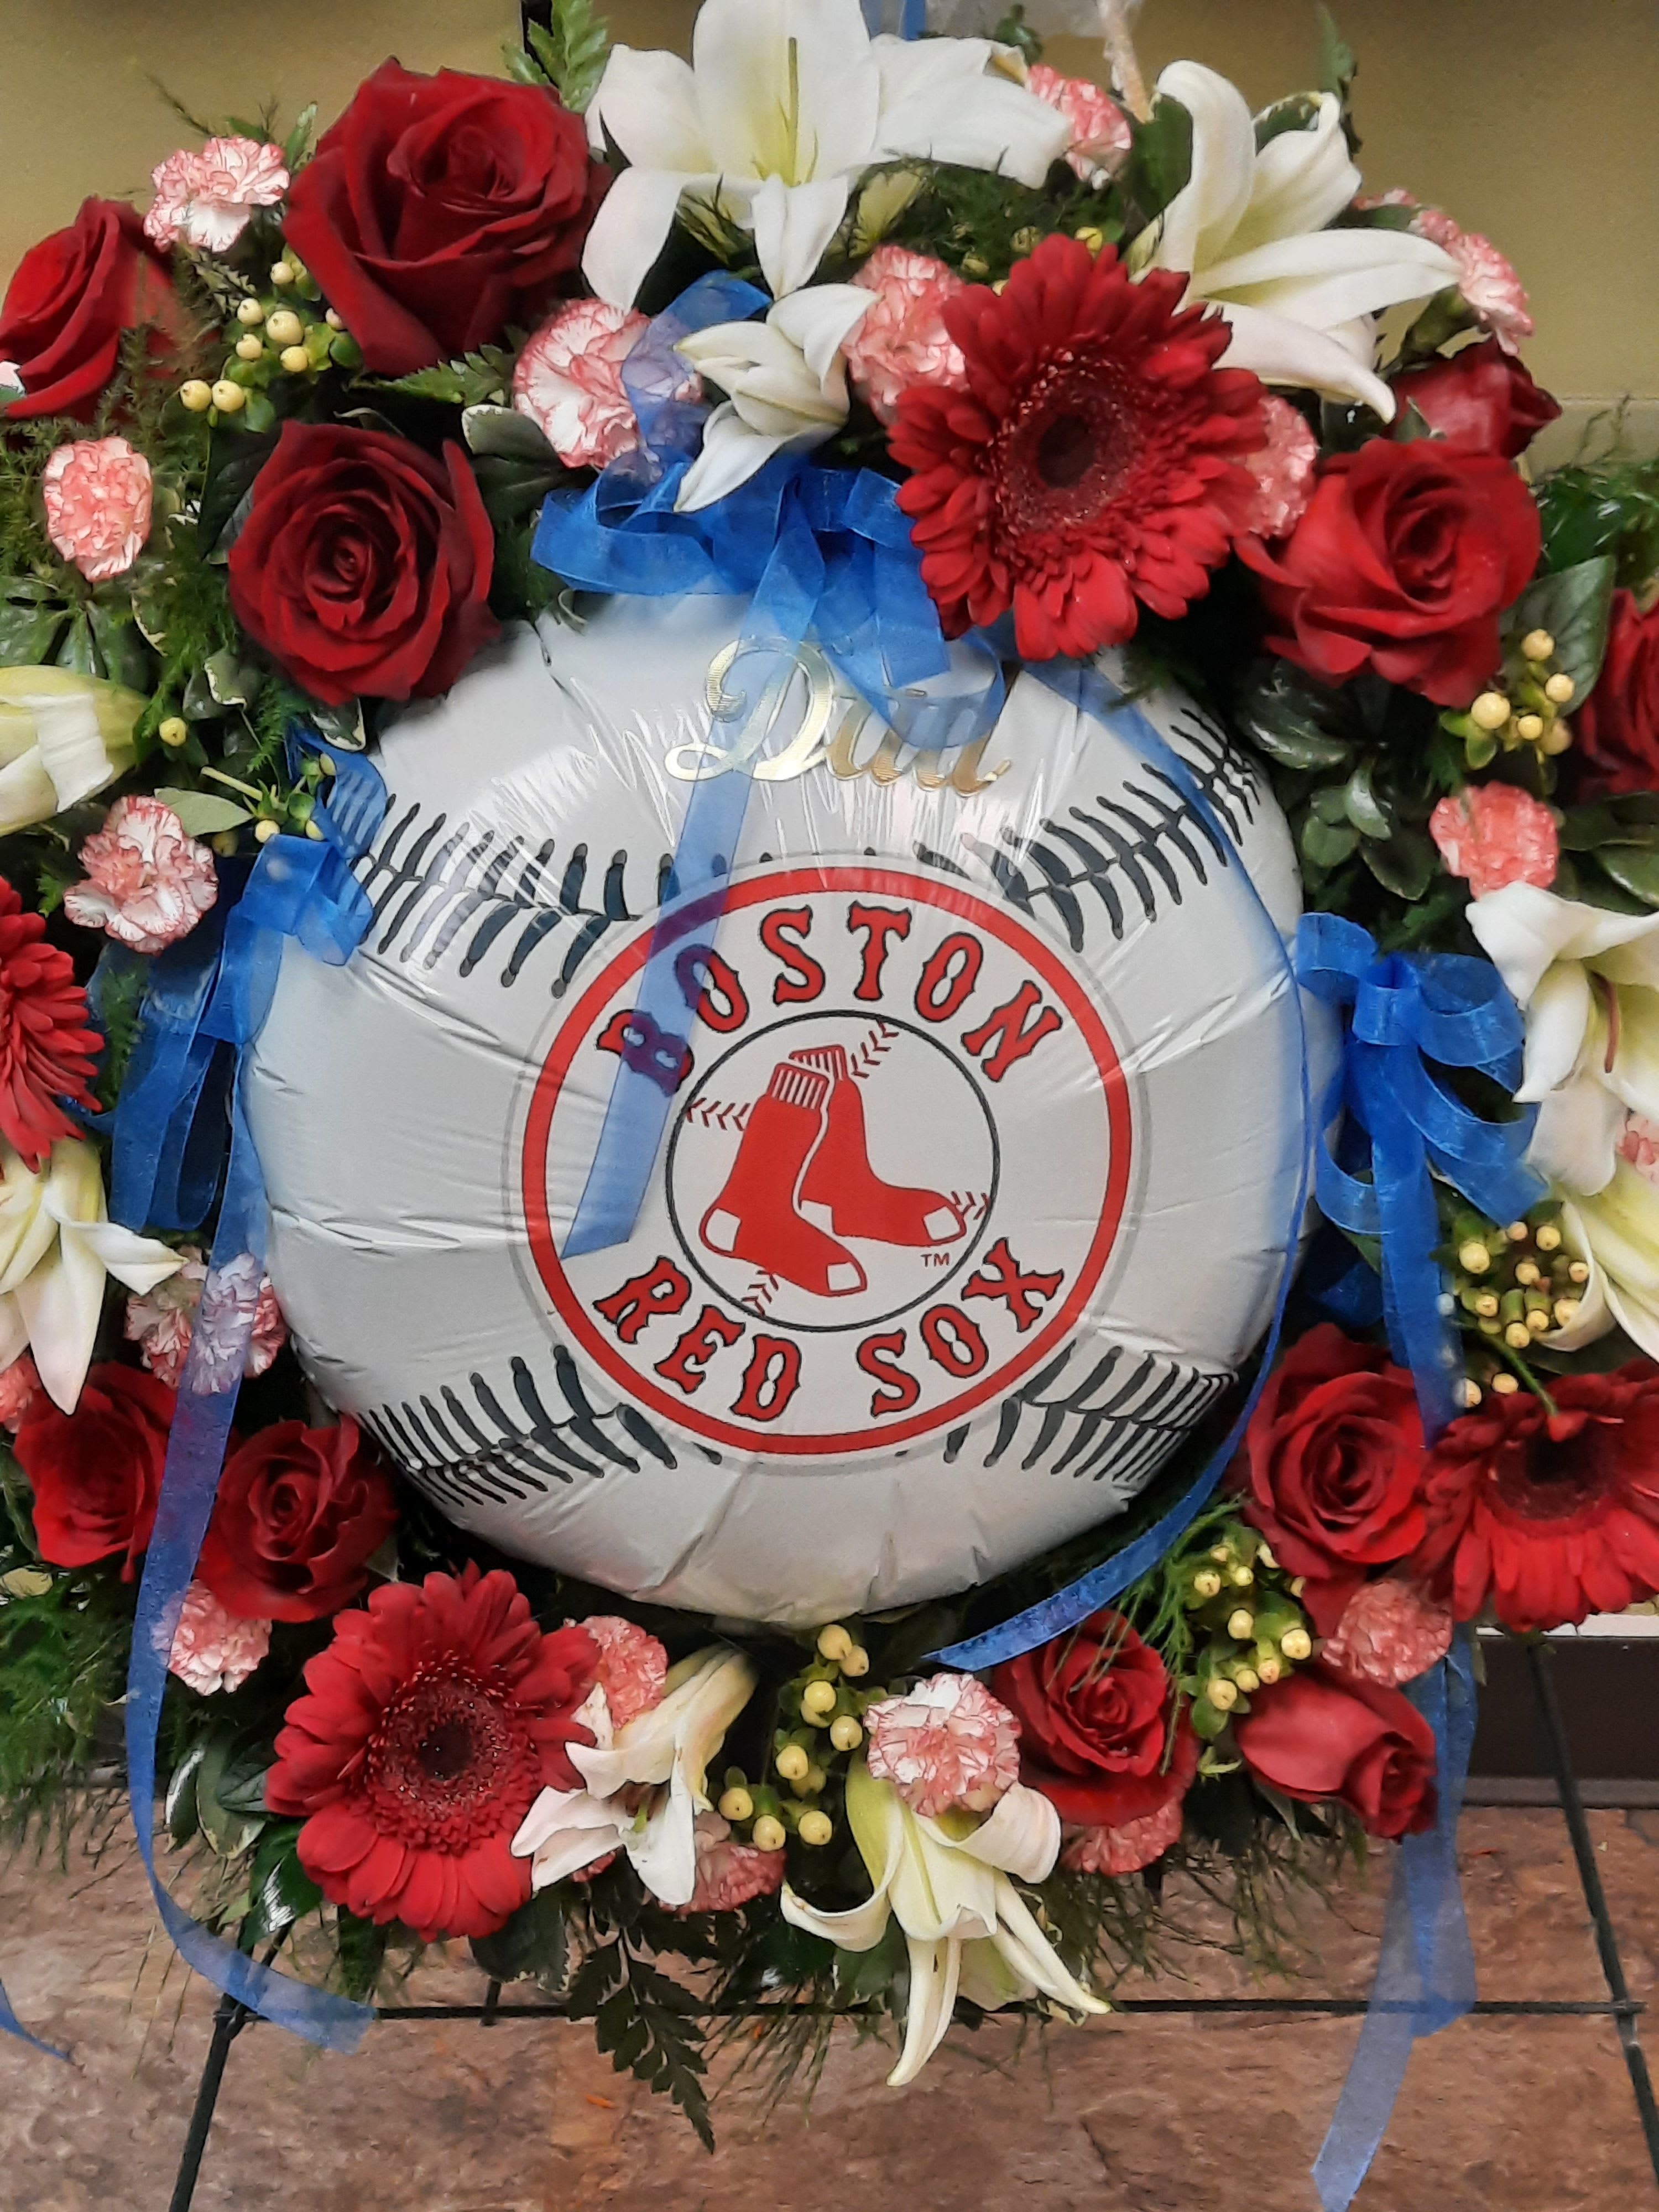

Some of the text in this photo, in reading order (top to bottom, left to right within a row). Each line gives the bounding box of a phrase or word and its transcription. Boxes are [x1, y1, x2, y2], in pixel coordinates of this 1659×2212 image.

[596, 901, 1063, 1096] BOSTON
[592, 1236, 1065, 1422] RED SOX
[920, 1251, 950, 1267] TM
